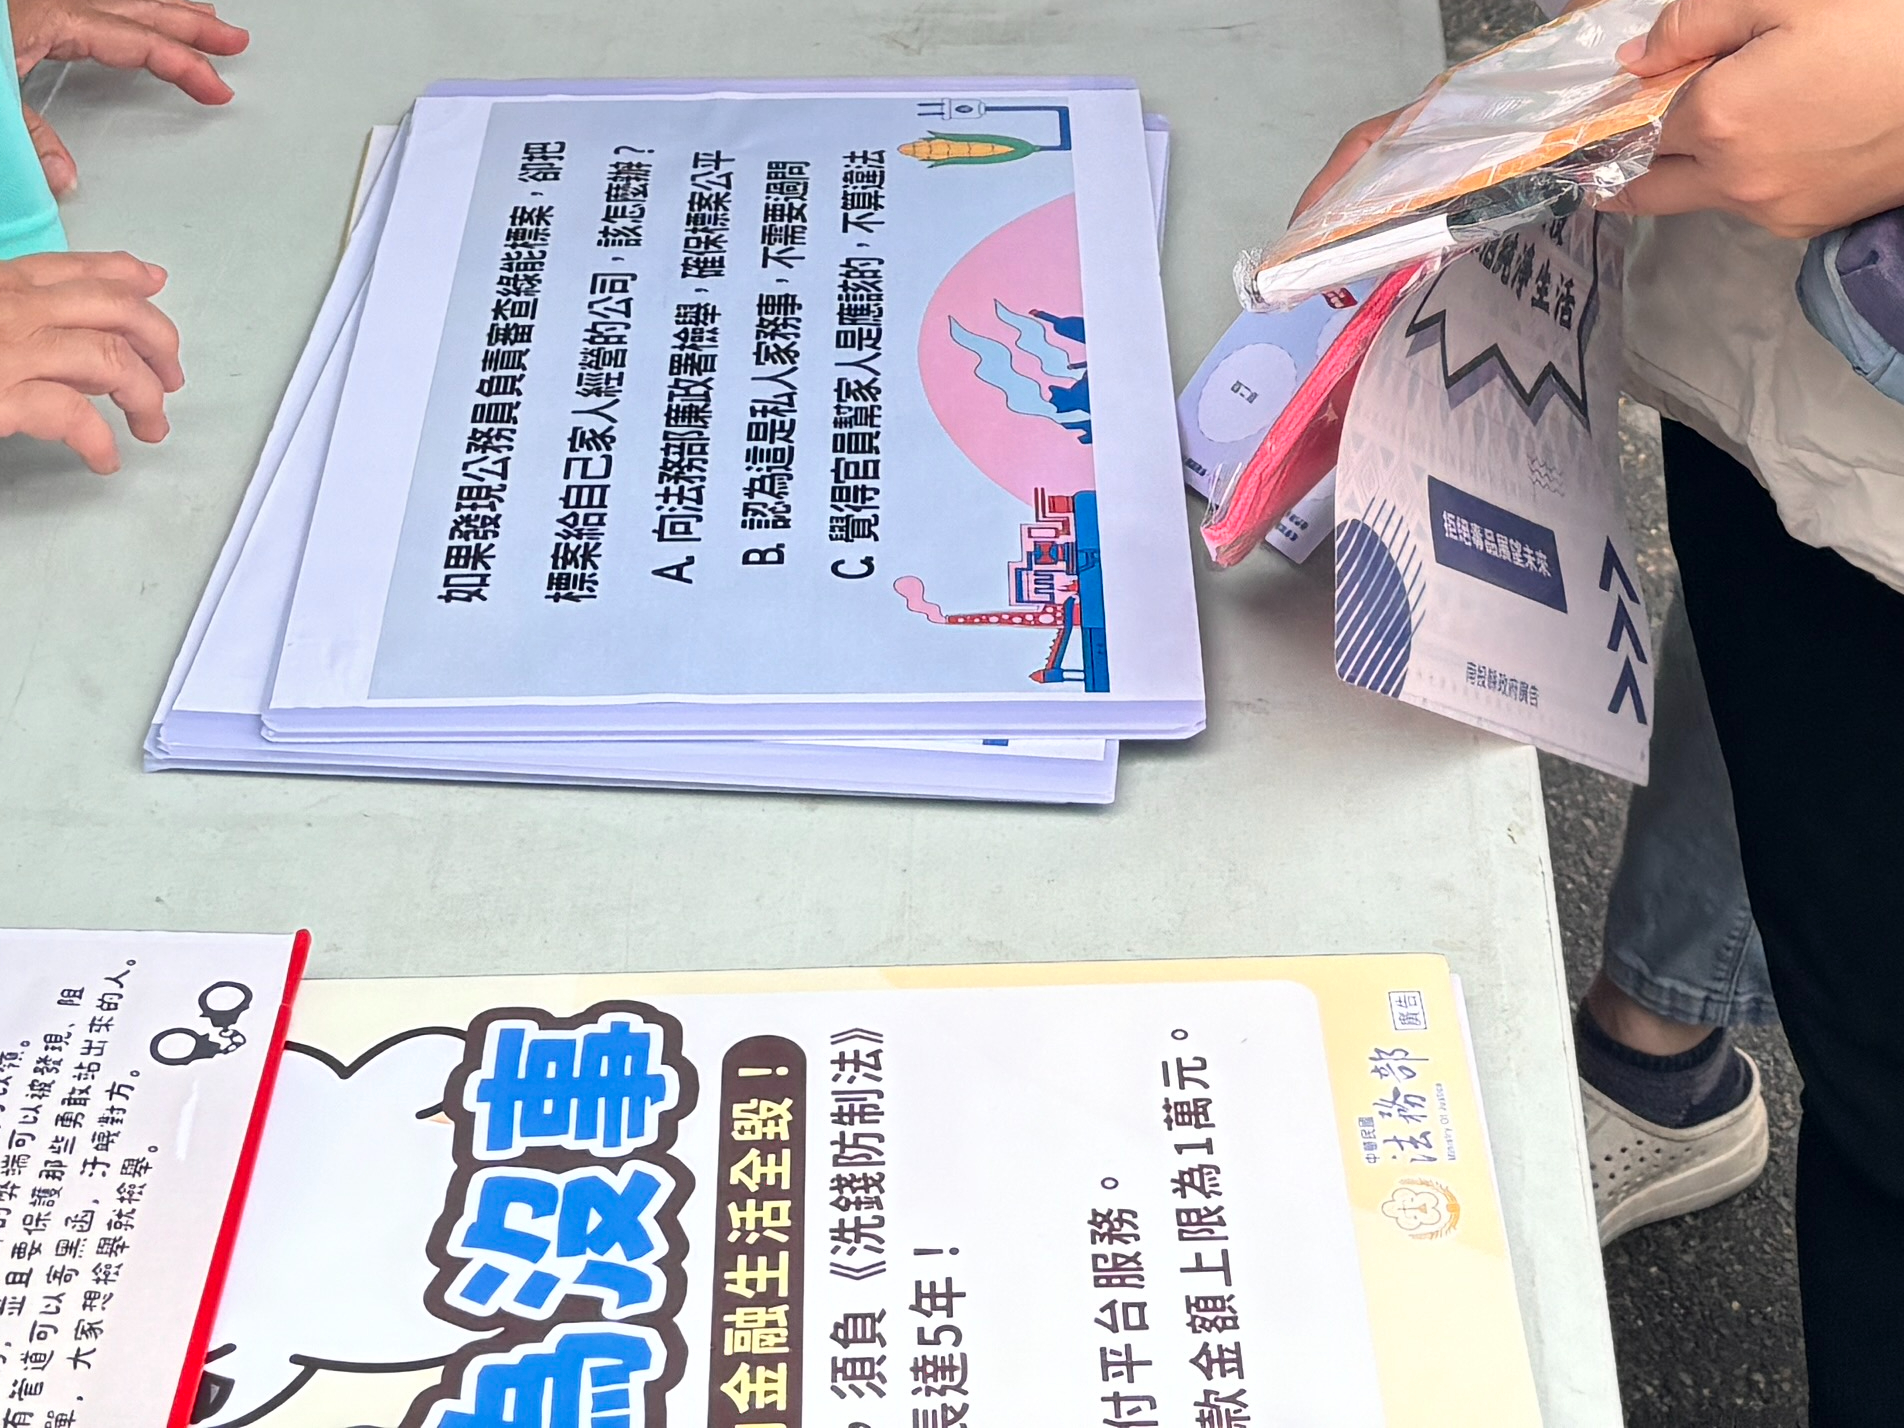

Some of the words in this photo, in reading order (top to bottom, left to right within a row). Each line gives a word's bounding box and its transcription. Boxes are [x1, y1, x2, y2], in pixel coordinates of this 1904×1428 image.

[436, 139, 567, 605] 如果發現公務員負責審查綠能標案，卻把
[544, 144, 655, 604] 標案給自己家人經營的公司，該怎麼辦？
[650, 554, 697, 585] A.
[741, 542, 786, 567] B.
[830, 555, 875, 580] C.
[1441, 509, 1552, 579] 拒絕毒品展望未來
[1394, 992, 1422, 1027] 廣告
[1367, 1047, 1438, 1164] 法務部
[1358, 1116, 1381, 1164] 中華民國
[719, 1062, 795, 1428] 金融生活全毀！
